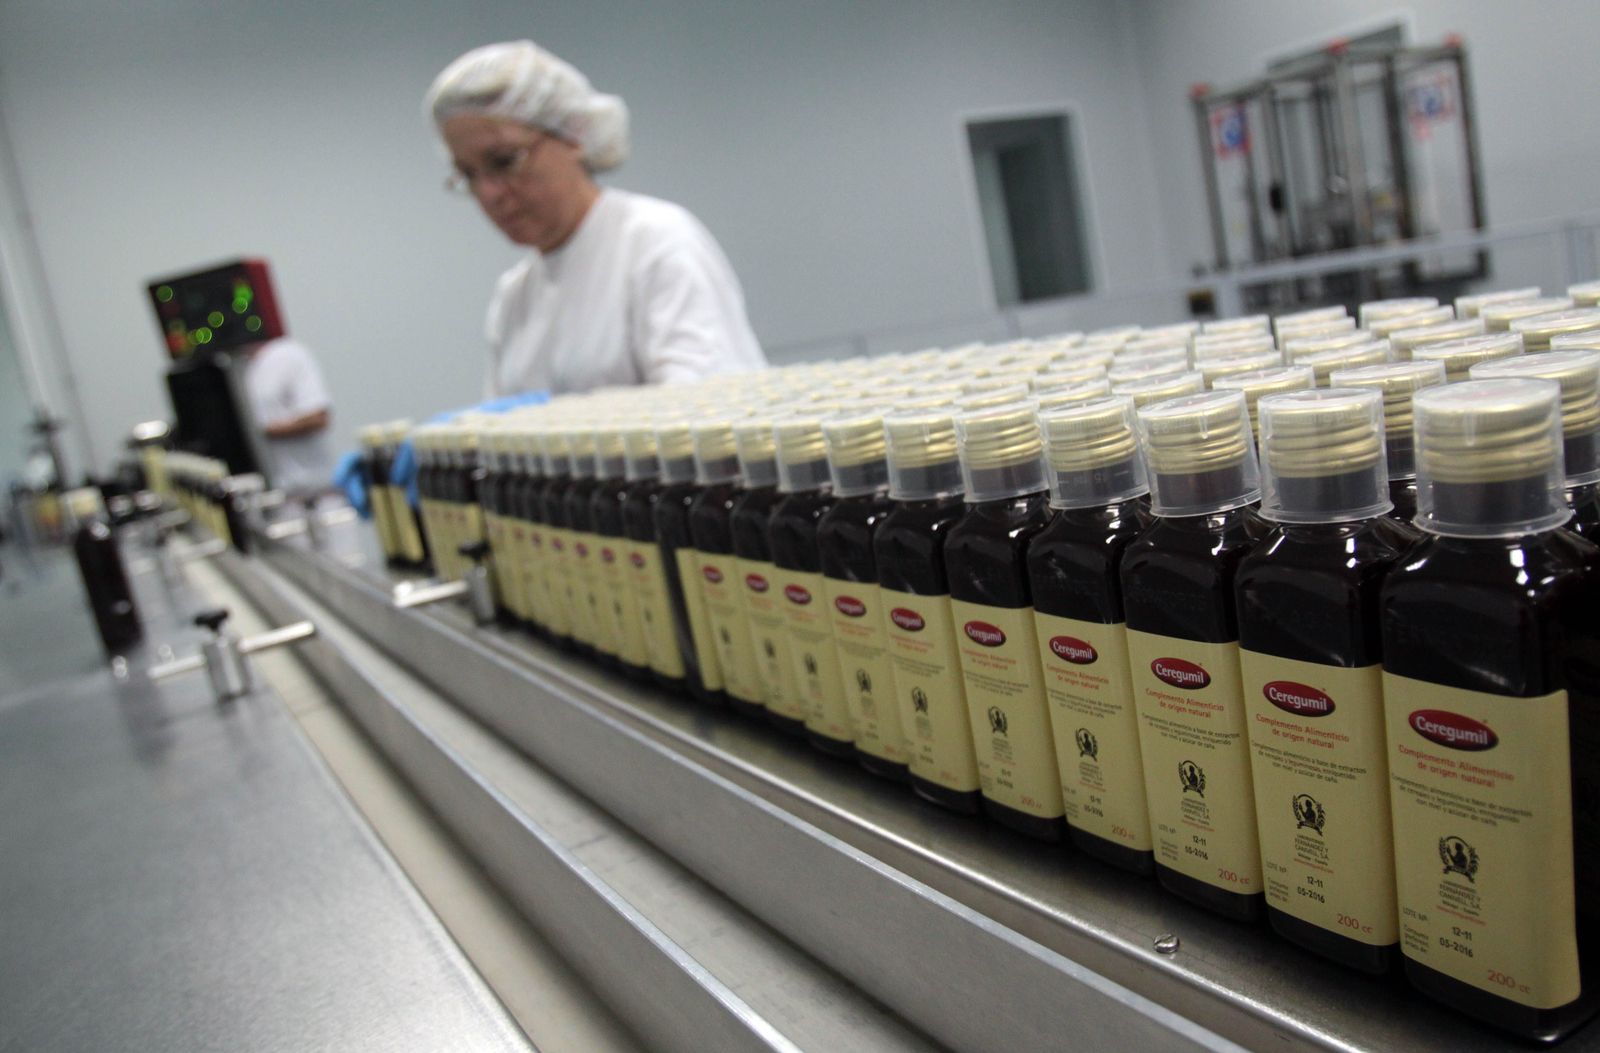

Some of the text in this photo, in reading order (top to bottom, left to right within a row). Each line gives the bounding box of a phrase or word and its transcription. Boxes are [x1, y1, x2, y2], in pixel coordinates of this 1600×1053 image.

[1053, 641, 1093, 660] Ceregumil
[1155, 663, 1204, 683] Ceregumil
[1268, 686, 1328, 712] Ceregumil
[1256, 713, 1303, 732] Complemento
[1305, 726, 1350, 743] Alimenticio
[1415, 715, 1488, 745] Ceregumil
[1272, 728, 1335, 750] de origen natural
[1399, 744, 1515, 781] Complemento Alimenticio
[1417, 761, 1495, 788] de origen natural
[1218, 868, 1237, 882] 200
[1307, 876, 1323, 888] 12-11
[1297, 886, 1325, 903] 05-2016
[1337, 913, 1373, 934] 200 cc
[1453, 926, 1473, 941] 12-11
[1440, 937, 1474, 958] 05-2016
[1487, 969, 1531, 995] 200 cc
